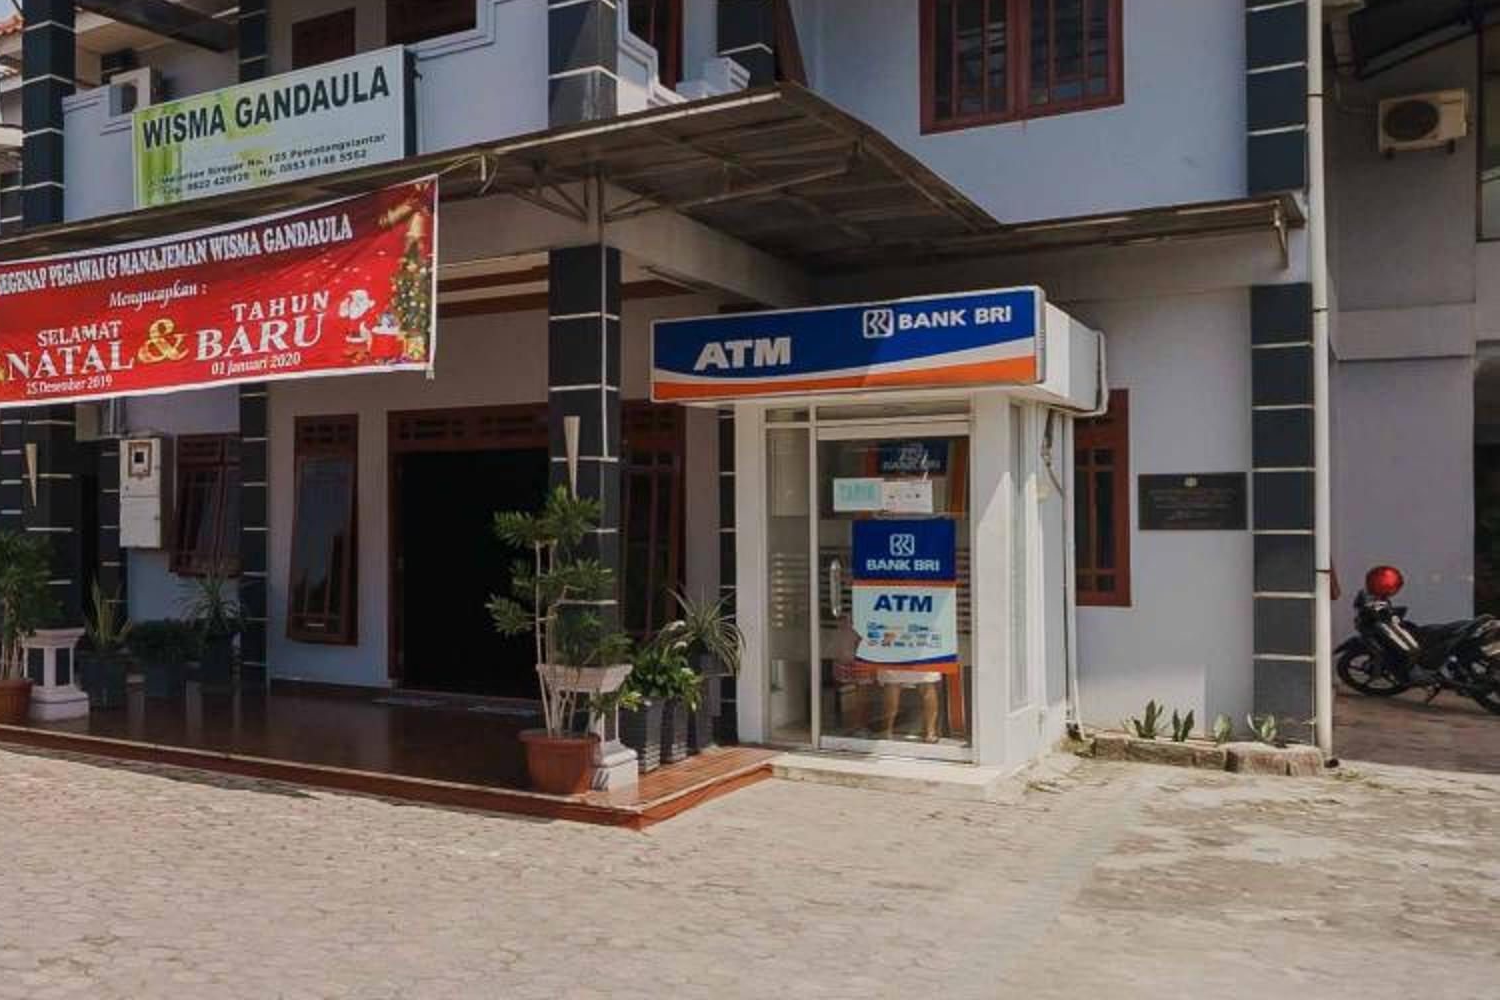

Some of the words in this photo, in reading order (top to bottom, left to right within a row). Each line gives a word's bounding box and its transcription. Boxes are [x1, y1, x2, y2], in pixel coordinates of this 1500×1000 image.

[143, 104, 226, 148] WISMA
[235, 66, 389, 129] GANDAULA
[50, 257, 105, 287] PEGAWAI
[107, 255, 117, 279] &
[209, 228, 263, 262] WISMA
[263, 213, 353, 252] GANDAULA
[109, 280, 197, 311] Mengucapkan
[231, 290, 329, 323] TAHUN
[899, 310, 967, 330] BANK
[975, 305, 1012, 324] BRI
[6, 339, 134, 381] NATAL
[137, 318, 189, 364] &
[195, 312, 325, 361] BARU
[37, 319, 122, 347] SELAMAT
[269, 351, 302, 369] 2020
[693, 336, 791, 371] ATM
[39, 378, 87, 393] Desember
[866, 559, 911, 572] BANK
[913, 559, 940, 572] BRI
[873, 594, 933, 613] ATM
